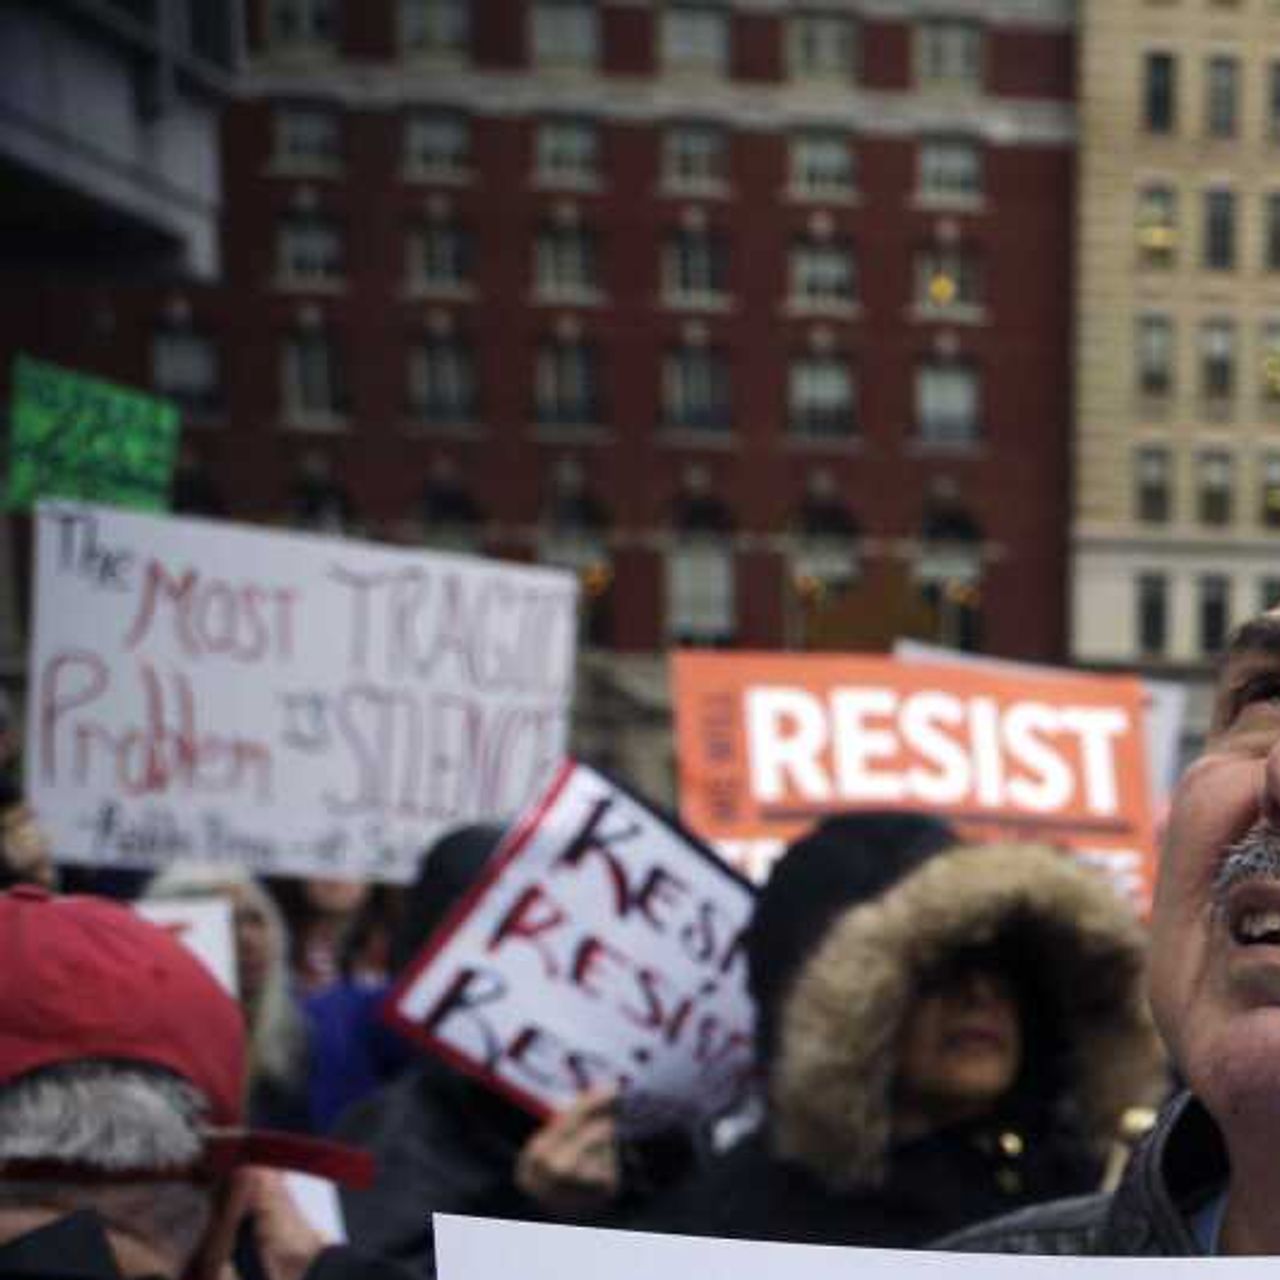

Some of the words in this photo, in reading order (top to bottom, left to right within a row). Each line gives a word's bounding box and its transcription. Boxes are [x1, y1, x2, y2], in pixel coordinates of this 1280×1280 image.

[57, 511, 134, 588] The
[127, 558, 296, 662] MOST
[41, 650, 272, 797] Problem
[744, 684, 1129, 818] RESIST
